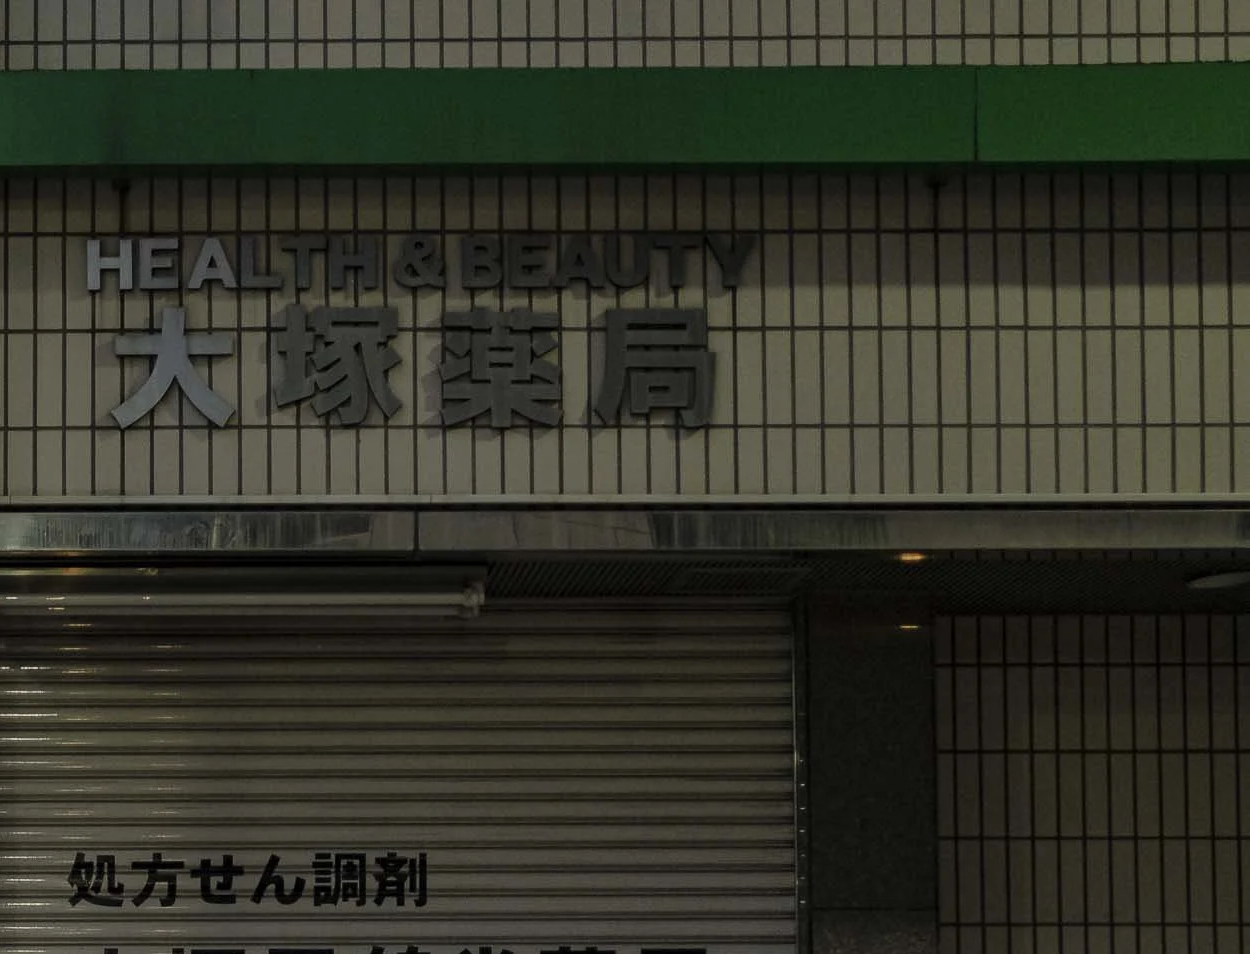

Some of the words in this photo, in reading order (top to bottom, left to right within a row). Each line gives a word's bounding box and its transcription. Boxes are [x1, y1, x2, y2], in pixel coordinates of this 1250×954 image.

[86, 237, 378, 292] HEALTH
[393, 237, 445, 290] &
[461, 236, 756, 290] BEAUTY
[111, 304, 717, 429] 大塚薬局
[66, 852, 429, 908] 処方せん調剤
